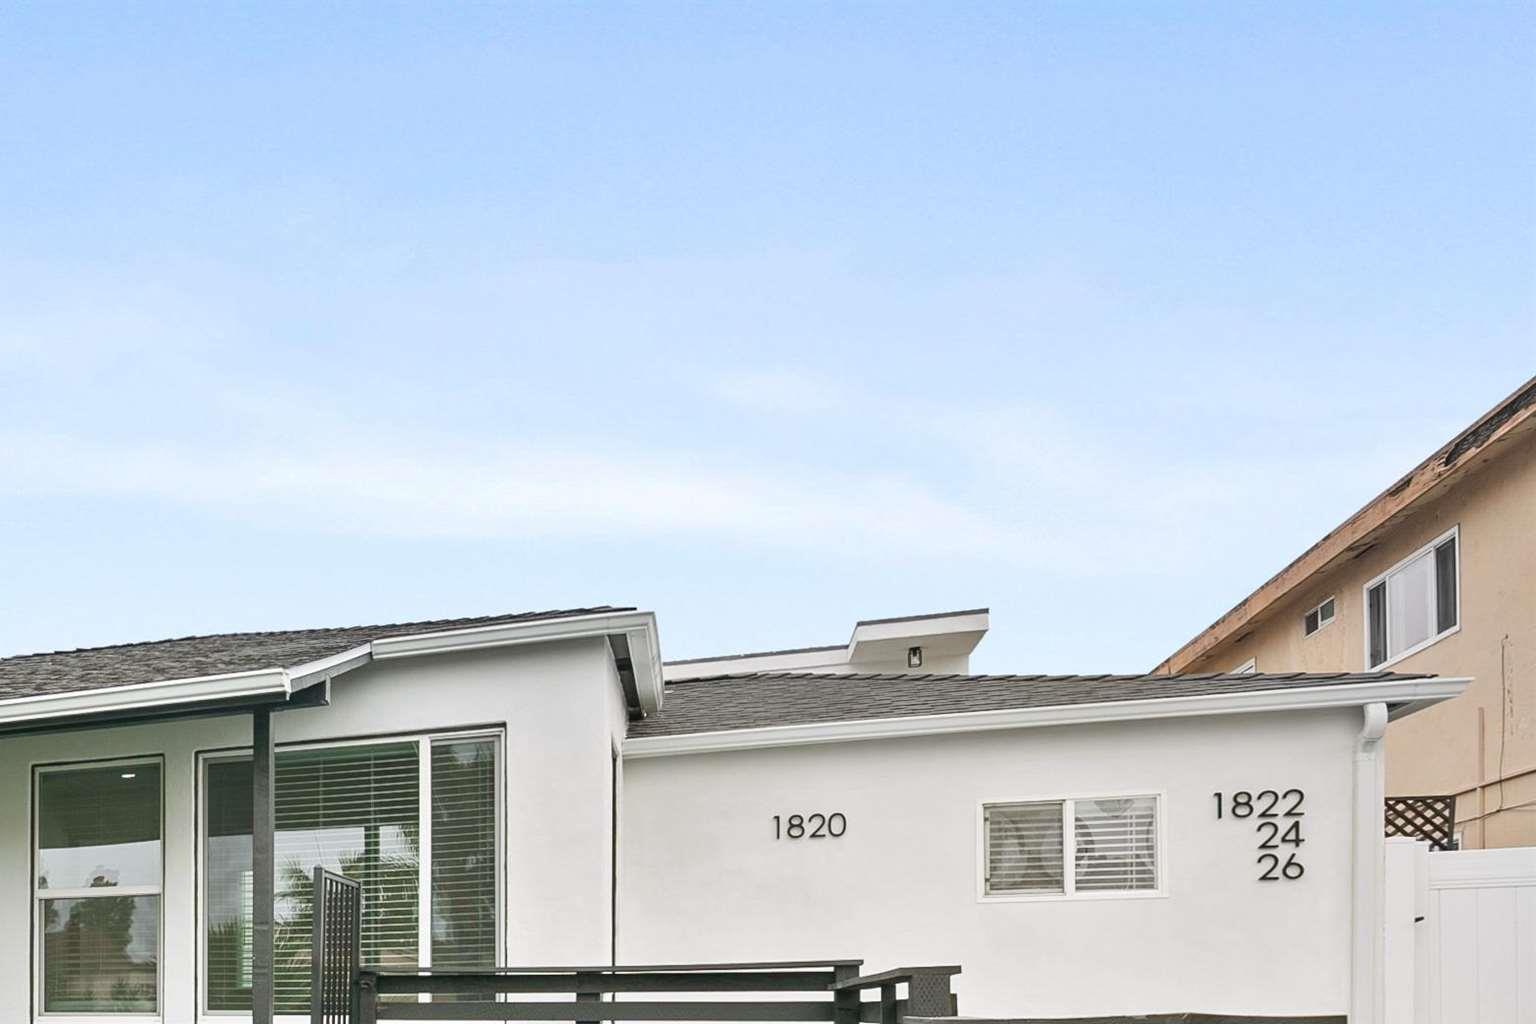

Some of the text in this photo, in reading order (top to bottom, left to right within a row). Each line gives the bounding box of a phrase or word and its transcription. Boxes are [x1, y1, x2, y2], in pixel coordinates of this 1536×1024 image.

[1213, 788, 1305, 820] 1822
[773, 812, 847, 840] 1820
[1256, 820, 1305, 850] 24
[1256, 852, 1305, 882] 26
